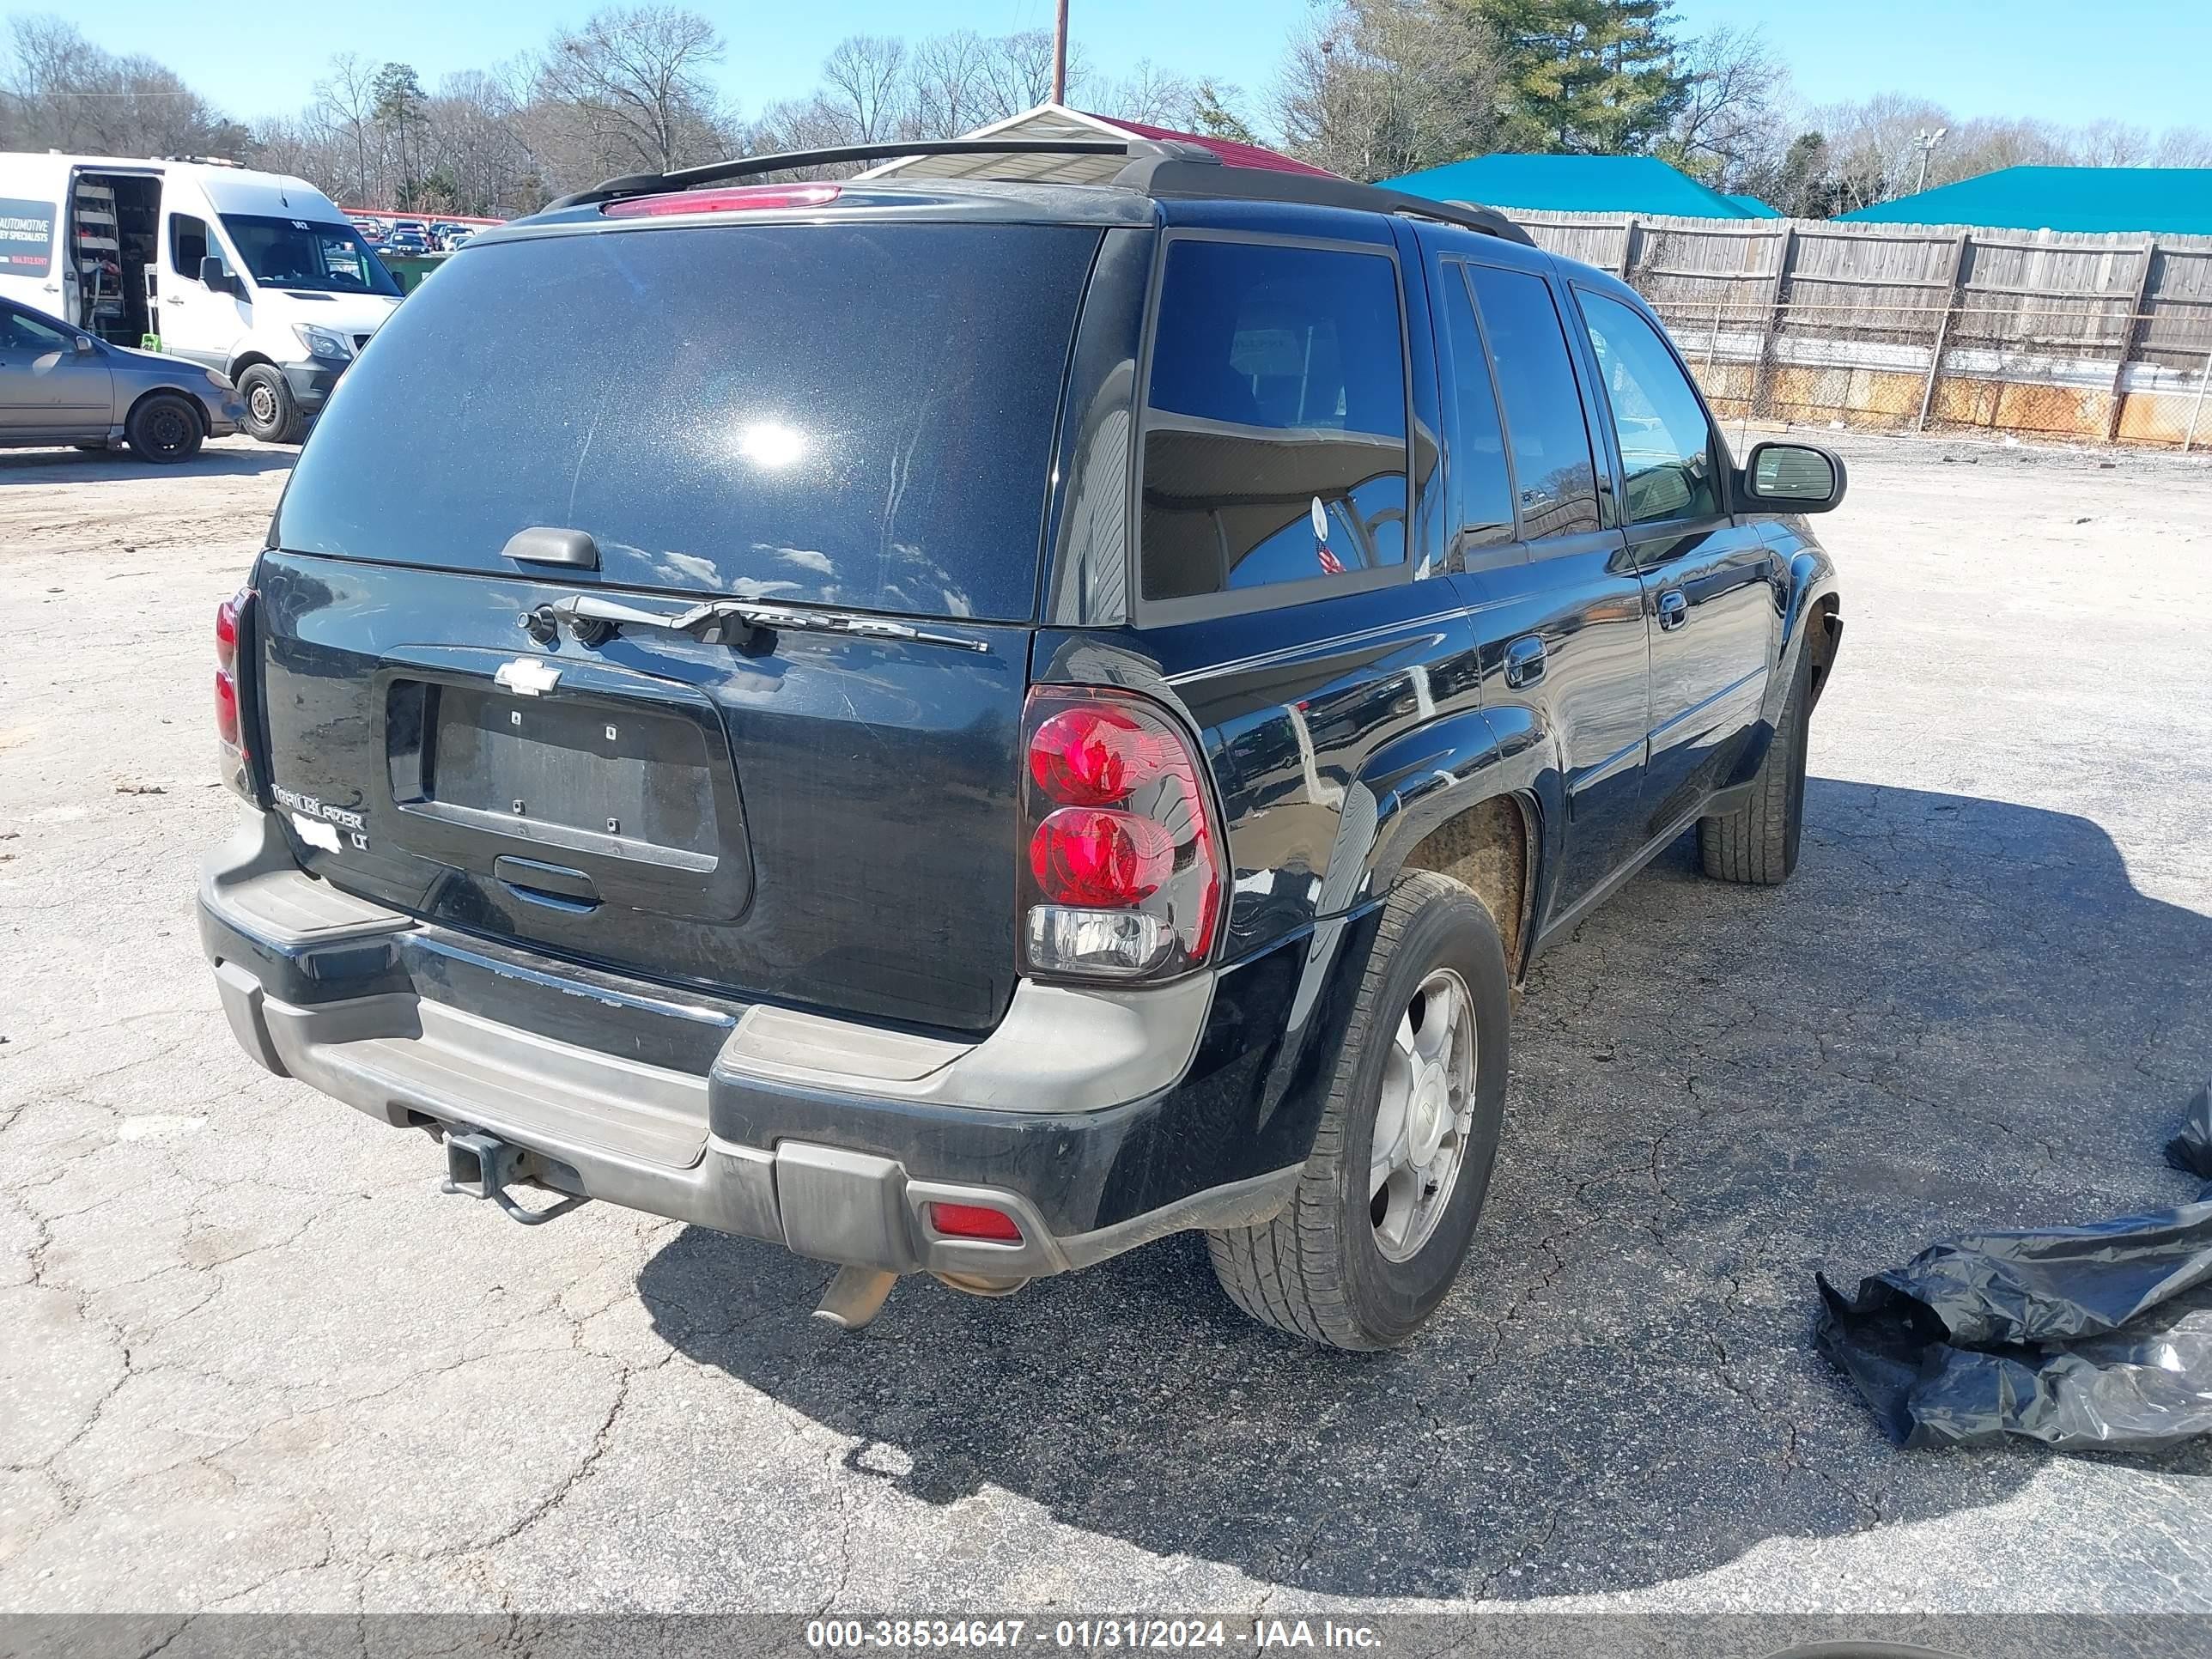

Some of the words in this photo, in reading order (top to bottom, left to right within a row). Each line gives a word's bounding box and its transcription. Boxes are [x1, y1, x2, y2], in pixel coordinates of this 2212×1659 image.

[0, 217, 50, 232] AUTOMOTIVE
[9, 231, 49, 242] SPECIALISTS
[270, 783, 365, 831] TRAILBLAZER
[350, 832, 368, 851] LT
